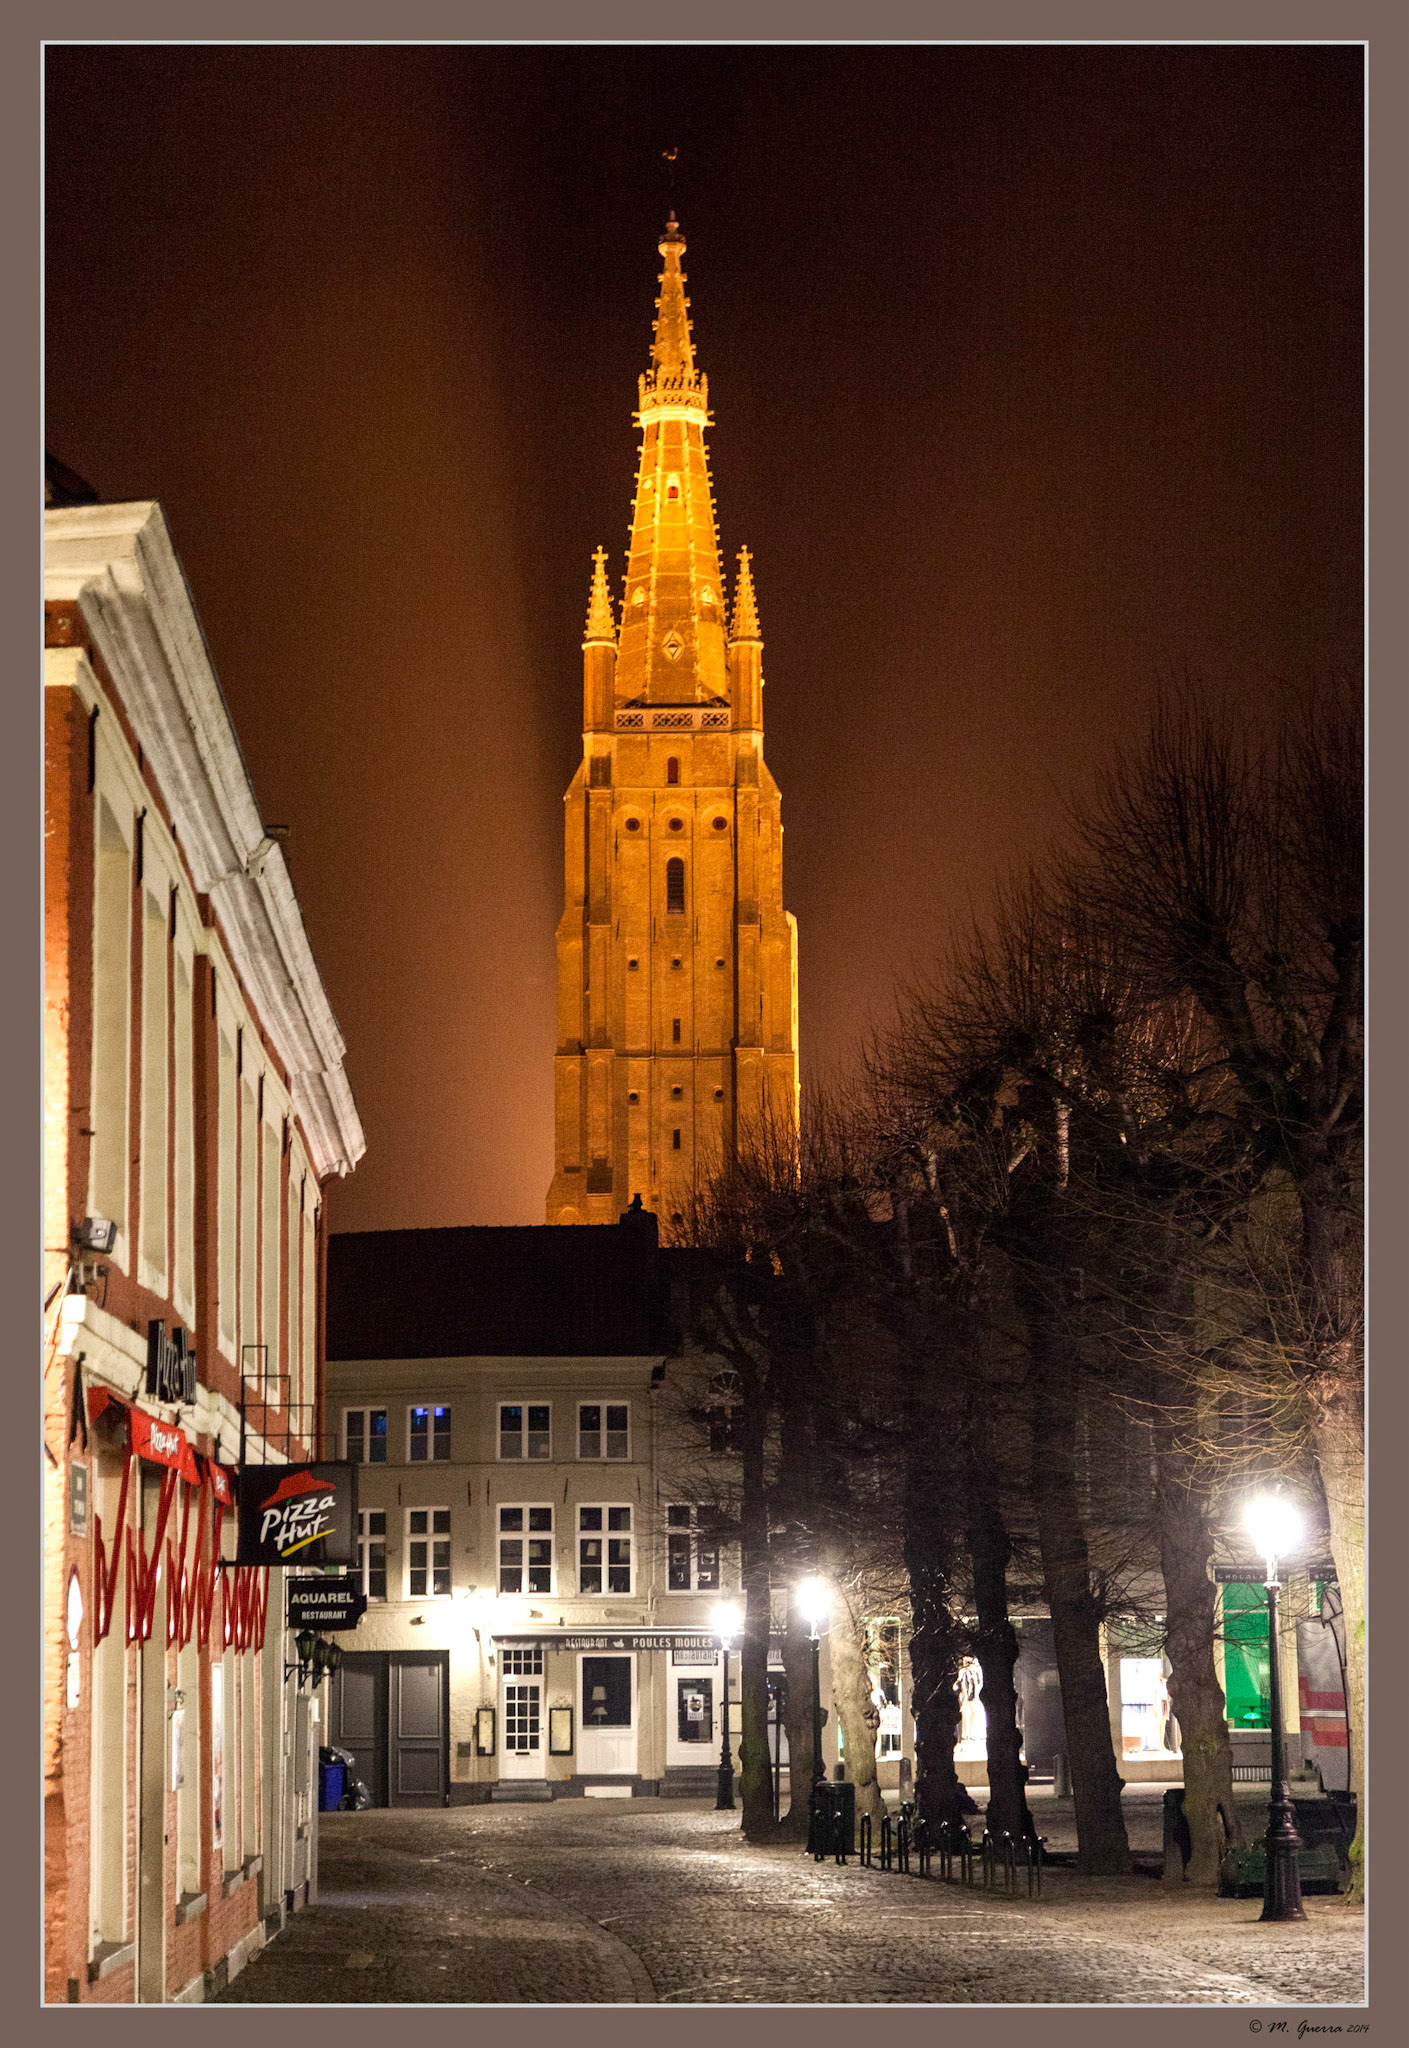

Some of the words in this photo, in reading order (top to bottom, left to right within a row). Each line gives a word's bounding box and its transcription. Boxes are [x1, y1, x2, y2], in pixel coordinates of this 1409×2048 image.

[260, 1495, 336, 1543] Pizza
[274, 1514, 330, 1551] Hut
[291, 1592, 354, 1604] AQUAREL
[301, 1610, 347, 1620] RESTAURANT
[565, 1638, 609, 1648] RESTAURANT
[632, 1637, 671, 1648] POULES
[675, 1637, 713, 1648] MOULES
